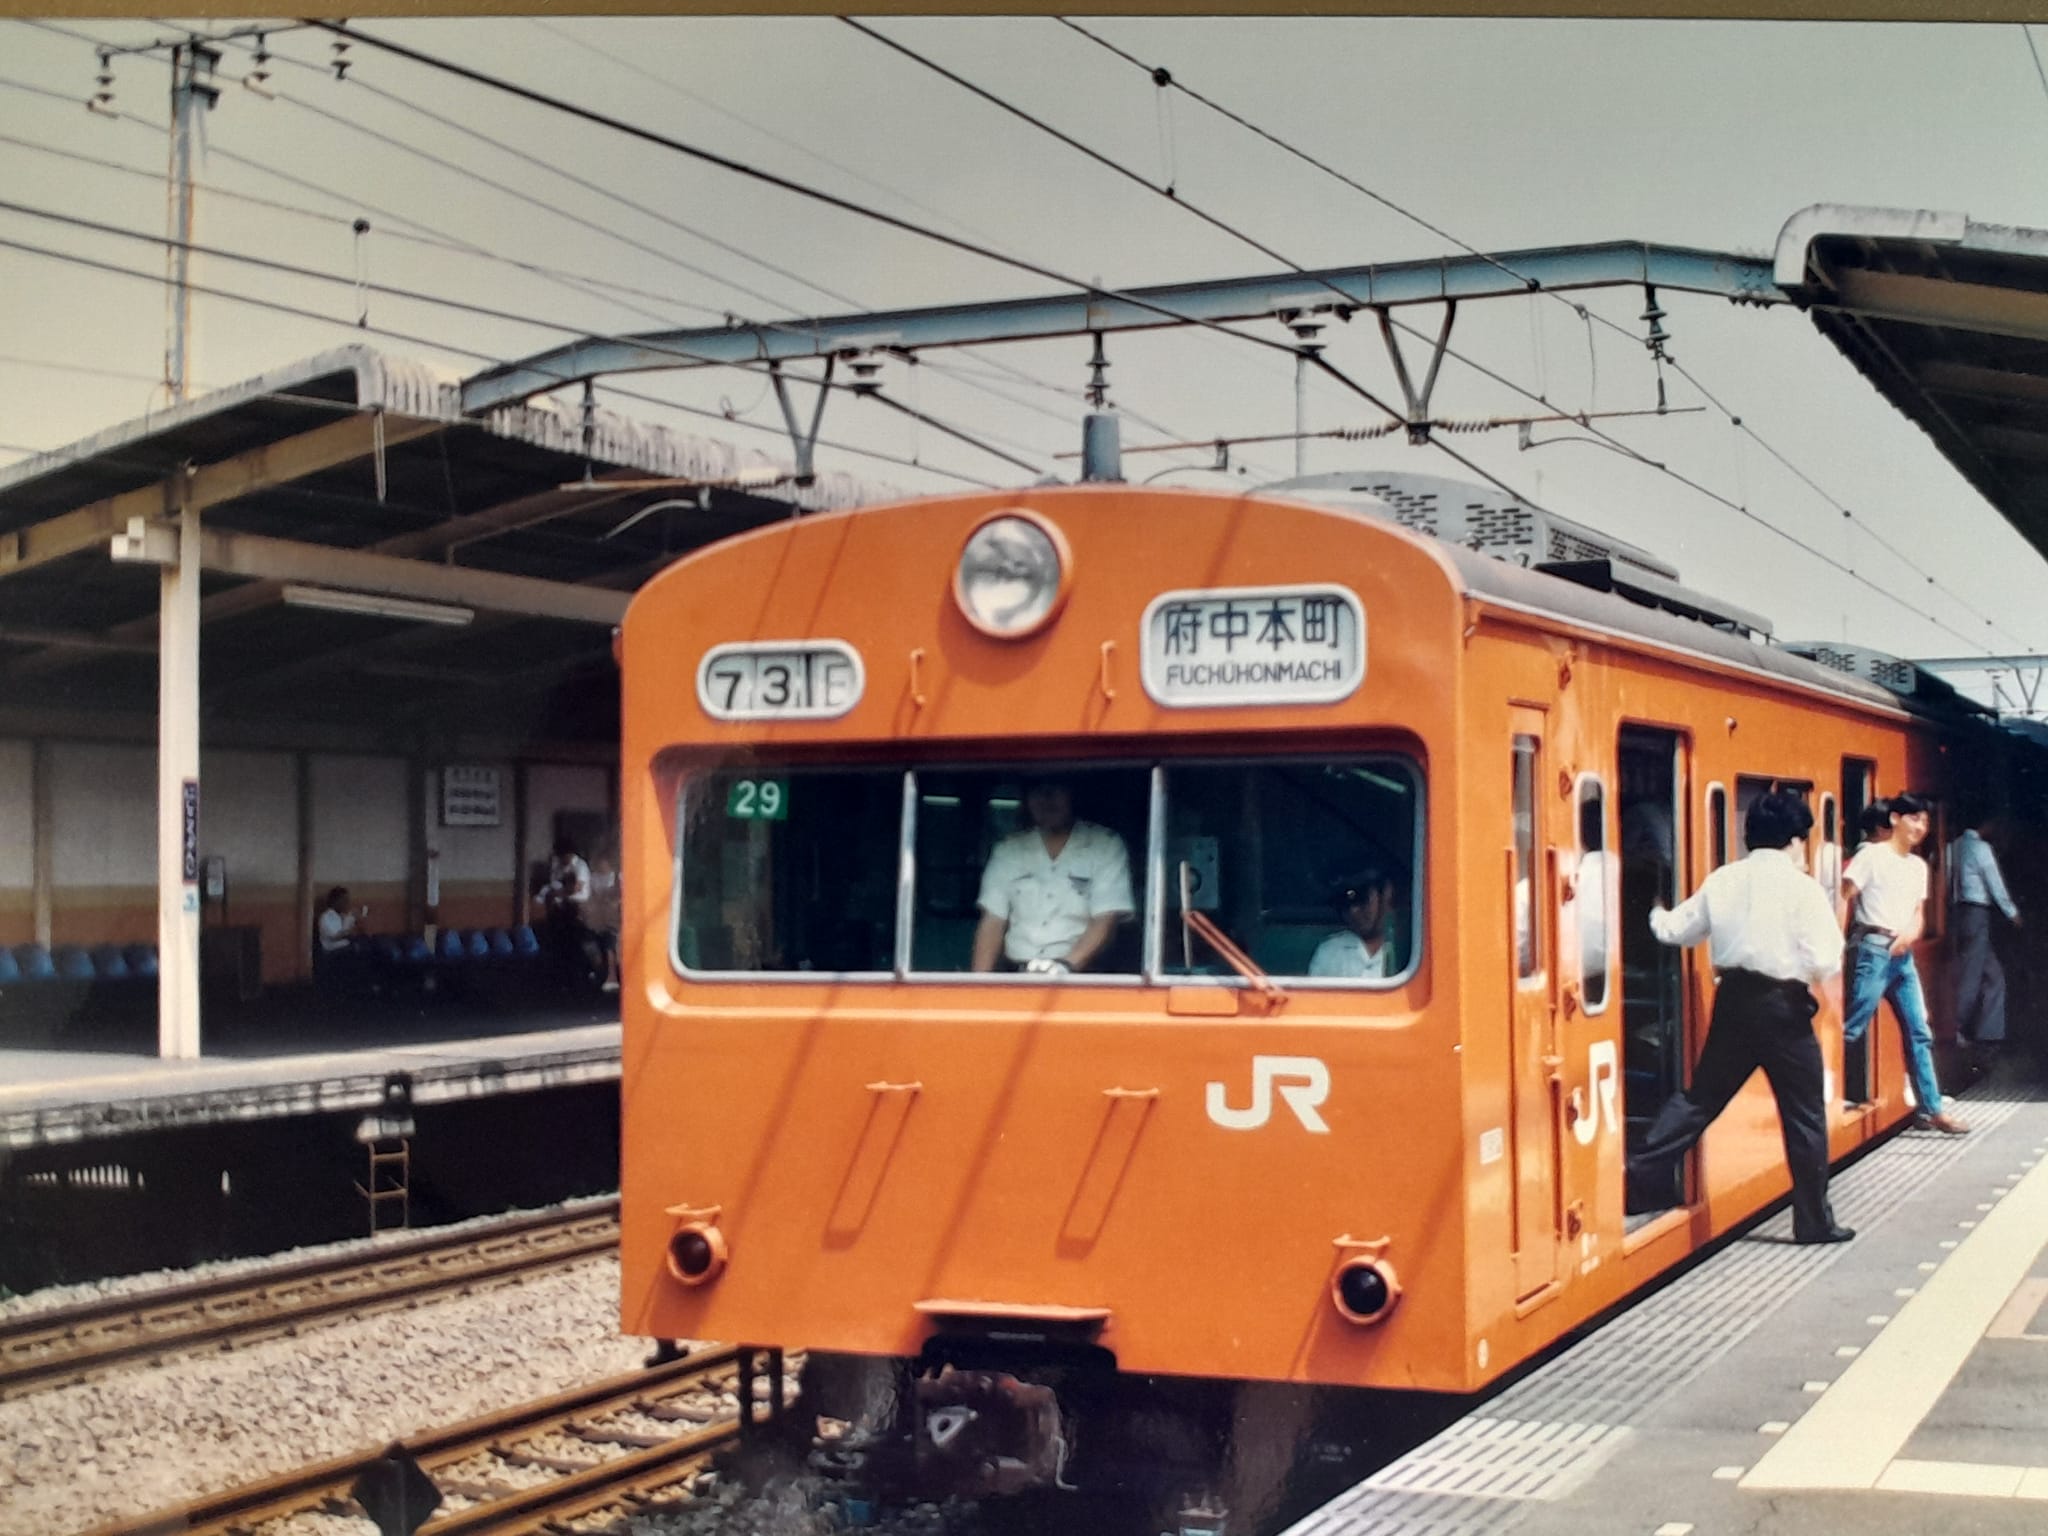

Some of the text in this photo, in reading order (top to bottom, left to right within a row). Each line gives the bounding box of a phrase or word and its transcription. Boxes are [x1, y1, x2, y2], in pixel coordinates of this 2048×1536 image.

[1165, 598, 1344, 655] 府中本町
[736, 780, 781, 815] 29
[1206, 1055, 1330, 1134] JR
[1573, 1039, 1617, 1146] JR
